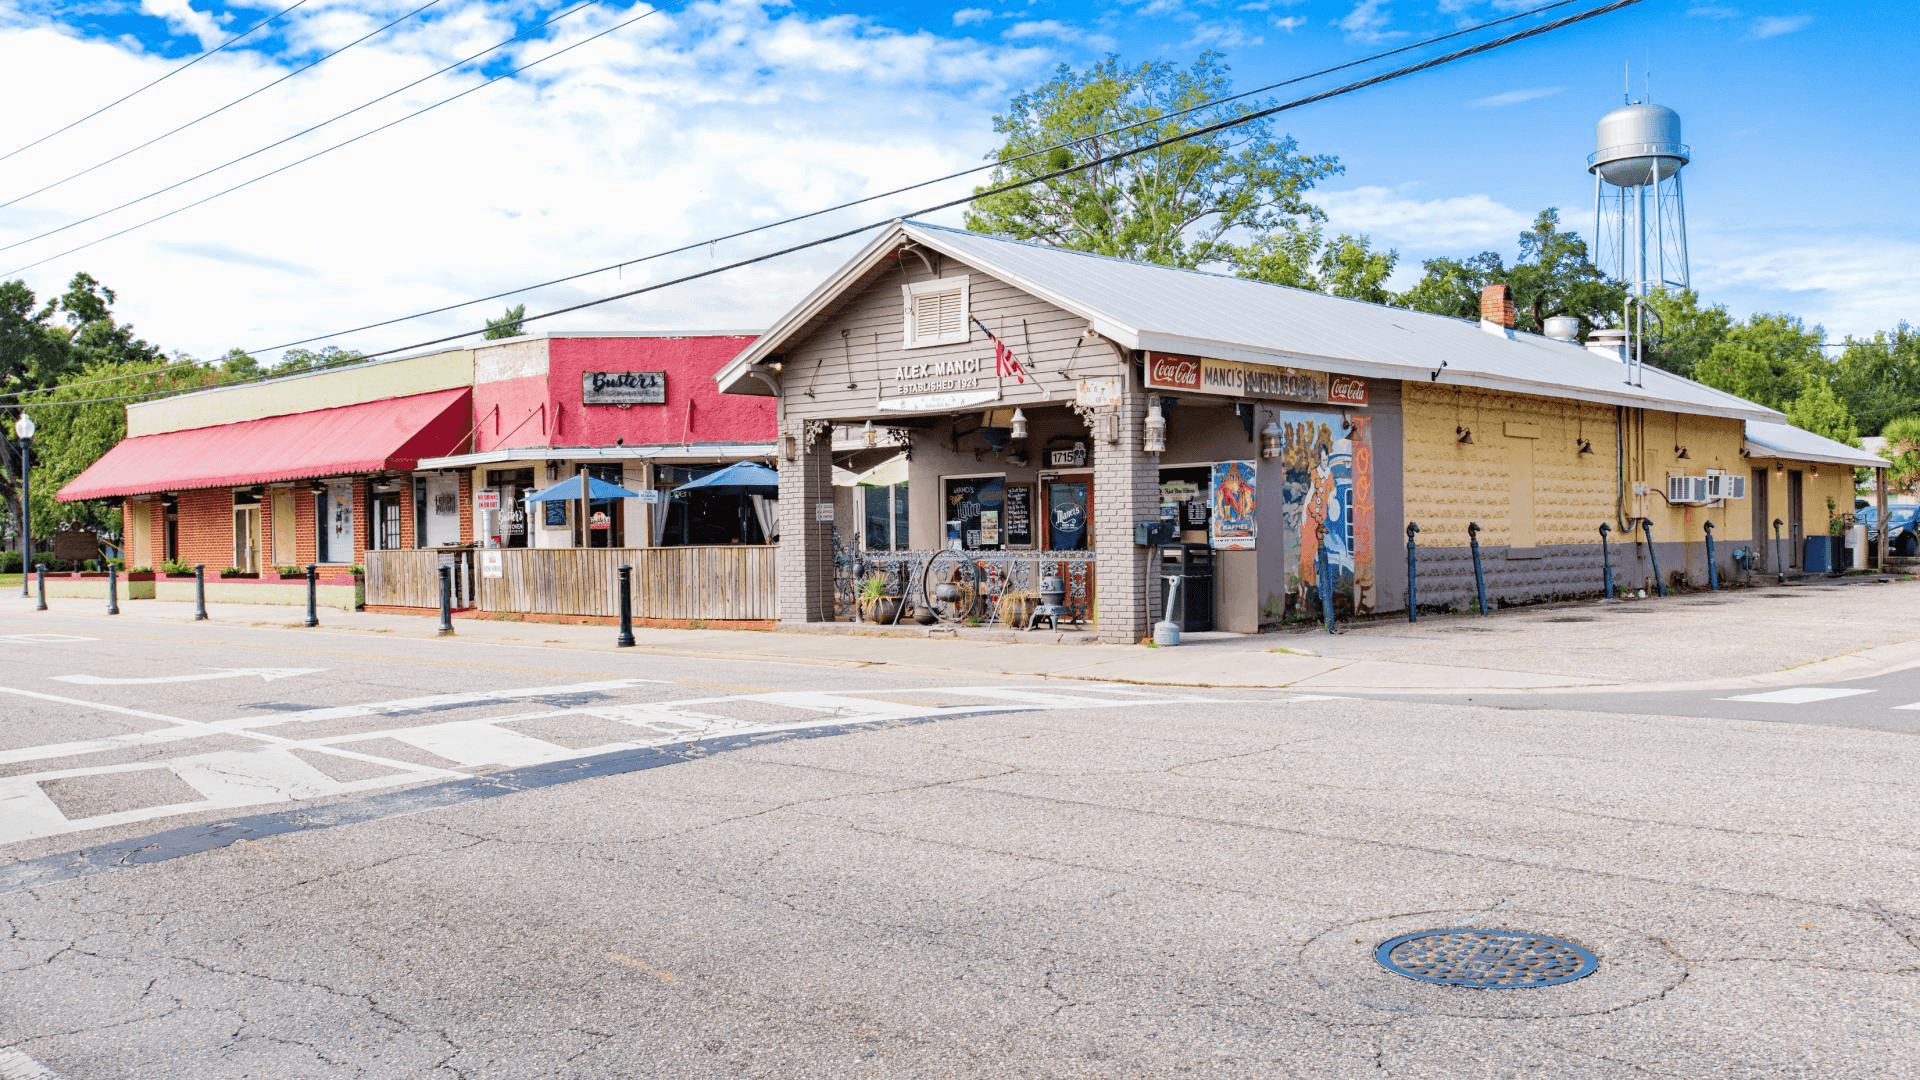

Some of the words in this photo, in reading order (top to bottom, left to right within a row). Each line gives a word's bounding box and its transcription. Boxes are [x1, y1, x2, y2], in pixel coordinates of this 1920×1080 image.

[895, 363, 929, 381] ALEX
[934, 357, 982, 377] MANCI
[1153, 359, 1199, 385] Coca-Cola
[1204, 366, 1243, 388] MANCI'S
[897, 380, 954, 394] ESTABLISHED
[957, 377, 979, 389] 1924
[1331, 379, 1365, 401] Coca-Cola
[1053, 451, 1074, 463] 1715
